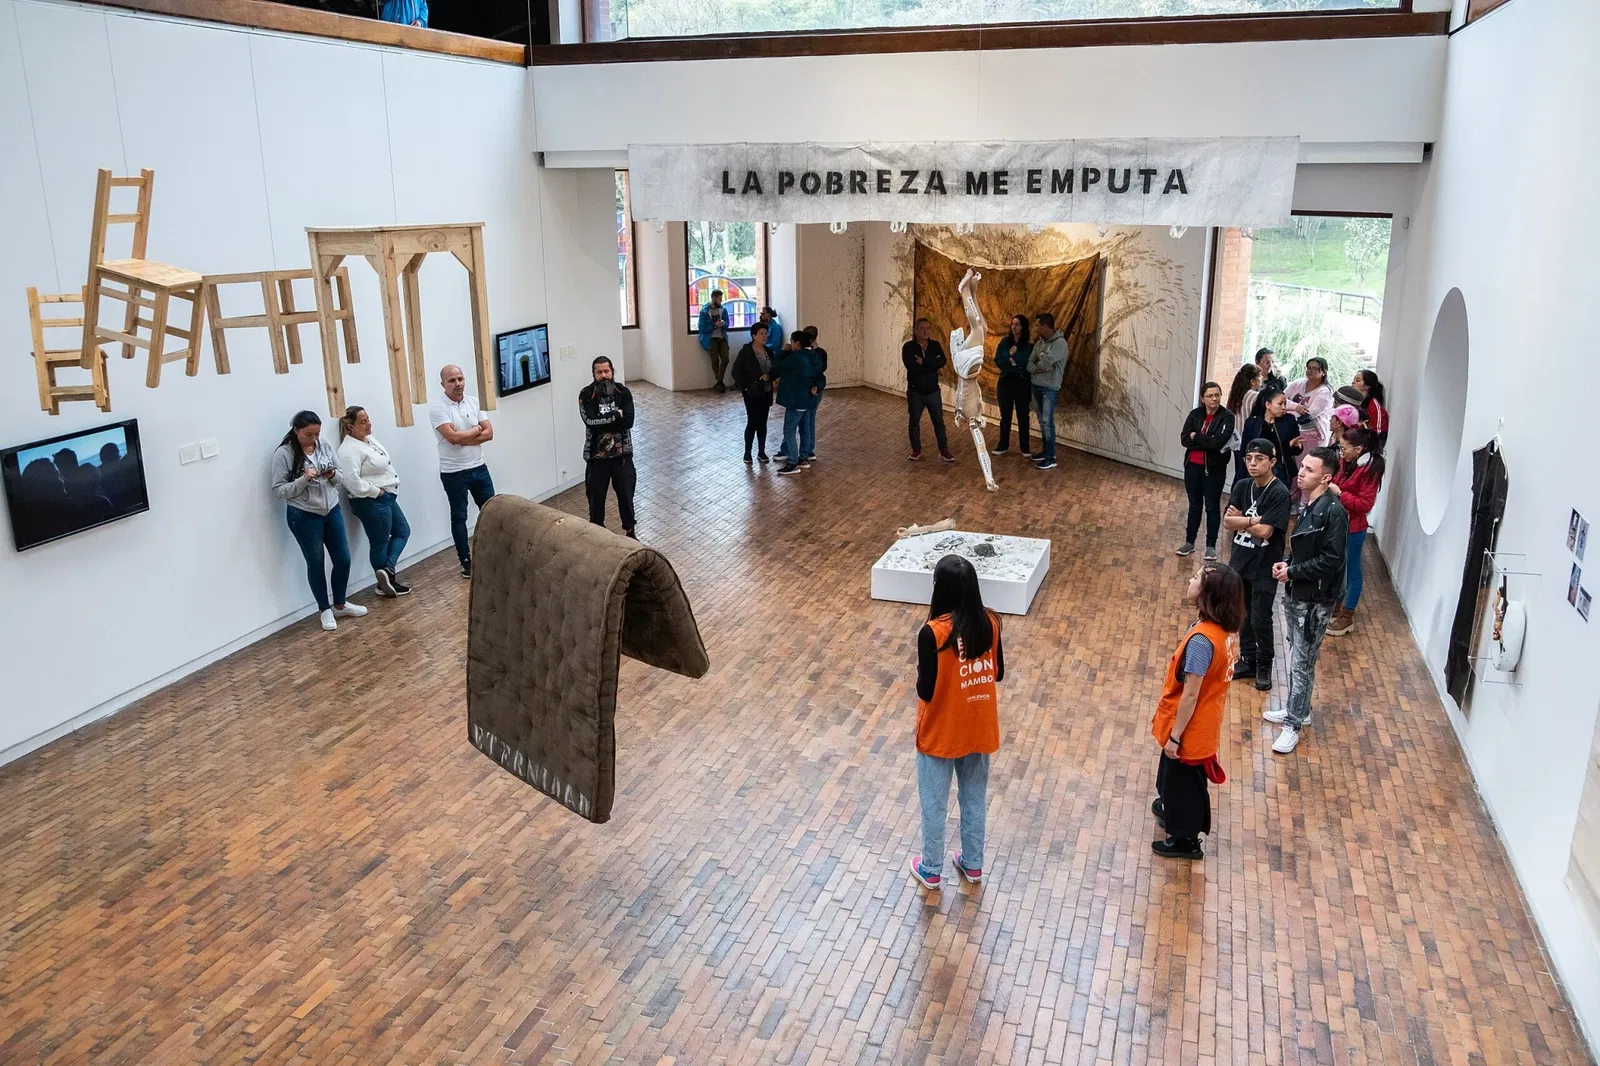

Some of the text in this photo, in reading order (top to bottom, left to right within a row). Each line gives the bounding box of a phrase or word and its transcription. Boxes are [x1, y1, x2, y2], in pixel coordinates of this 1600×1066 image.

[722, 167, 1188, 195] LA POBREZA ME EMPUTA
[960, 675, 993, 690] MAMBO
